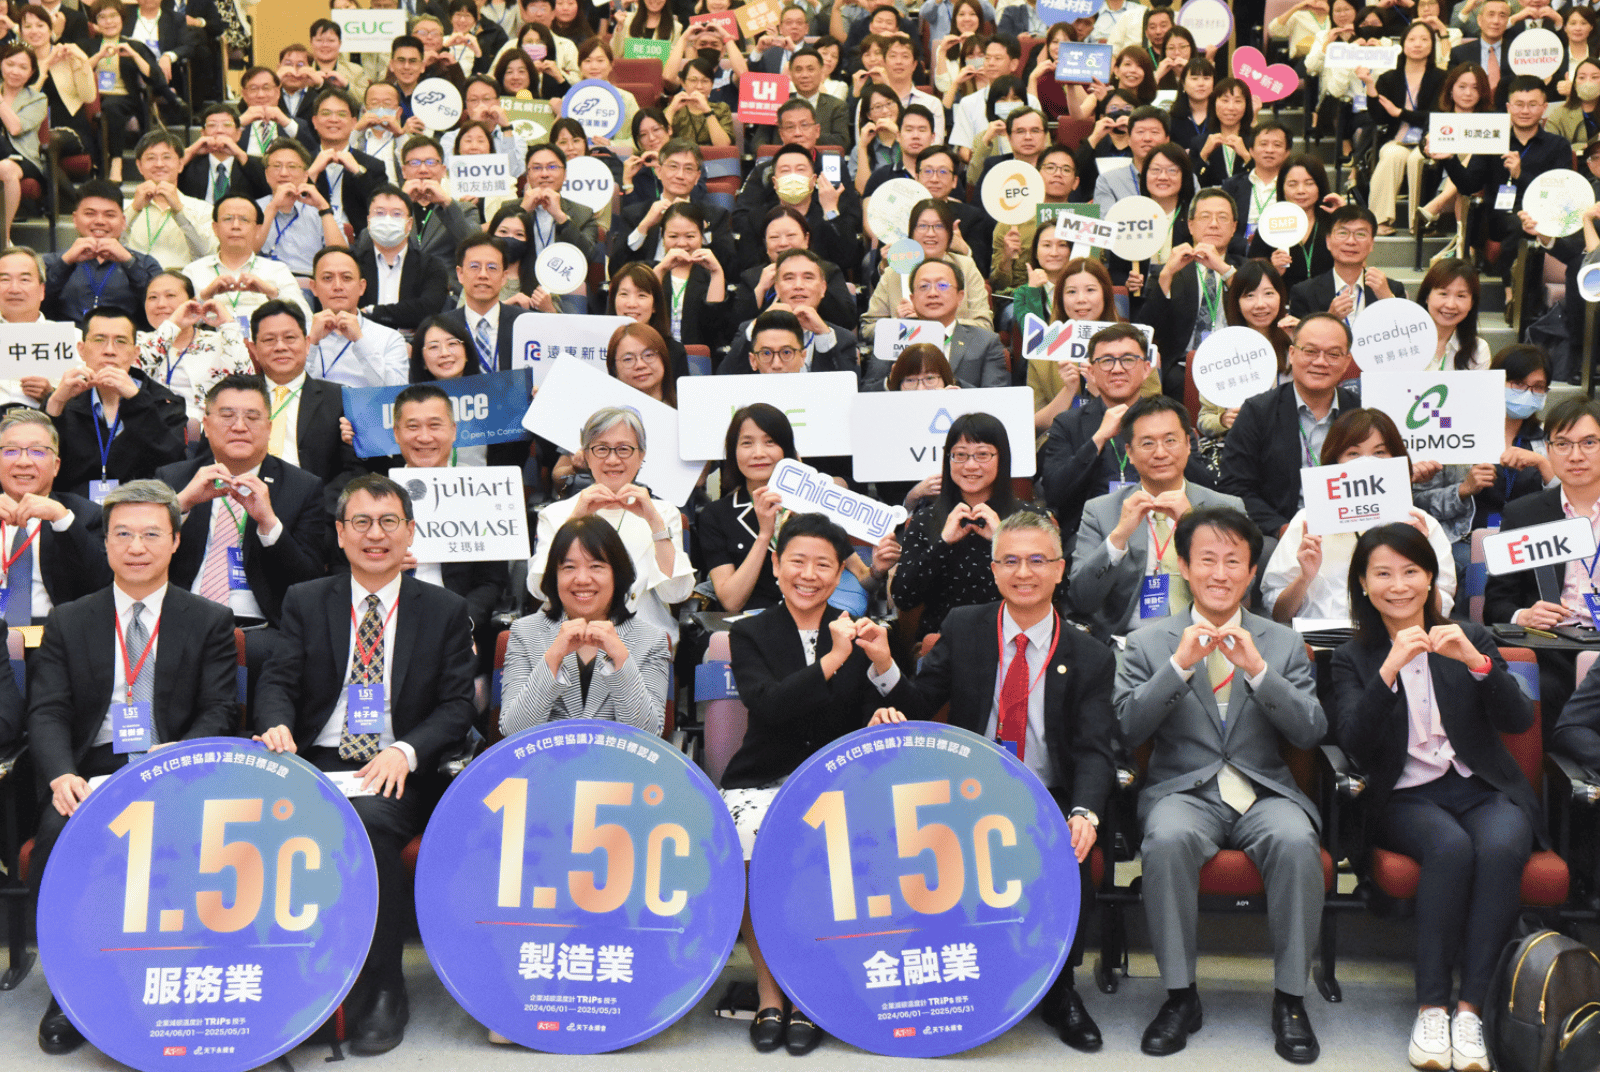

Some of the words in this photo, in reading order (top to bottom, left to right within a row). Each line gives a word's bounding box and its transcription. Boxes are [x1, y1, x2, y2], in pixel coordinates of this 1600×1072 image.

[344, 21, 393, 35] GUC
[646, 45, 662, 55] 100
[1329, 45, 1395, 65] Chicony
[438, 104, 459, 117] FSP
[500, 99, 512, 111] 13
[595, 109, 615, 117] FSP
[457, 164, 505, 178] HOYU
[1005, 187, 1030, 199] EPC
[1063, 218, 1112, 237] MXIC
[1357, 319, 1428, 347] arcadyan
[8, 342, 73, 361] 中石化
[1199, 347, 1267, 375] arcadyan
[460, 429, 486, 440] Open
[776, 465, 893, 538] Chicony
[517, 941, 635, 984] 製造業
[862, 942, 981, 989] 金融業
[142, 964, 264, 1005] 服務業
